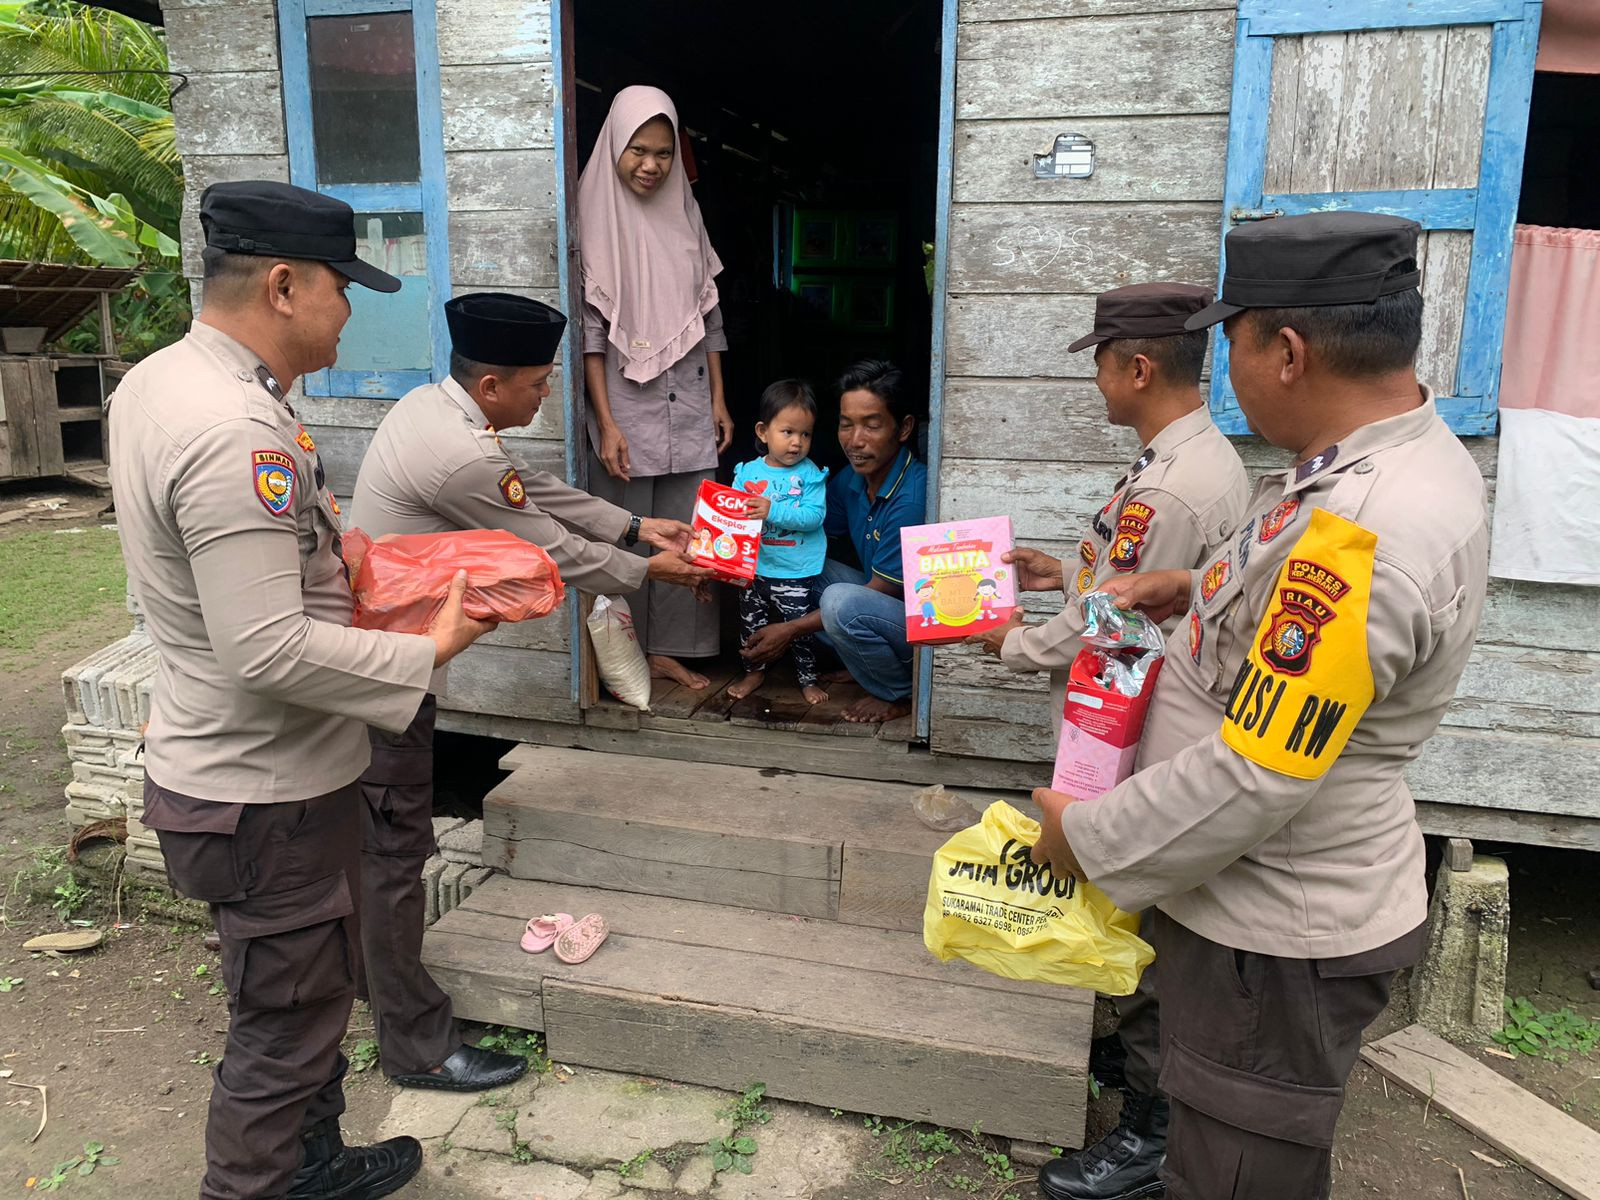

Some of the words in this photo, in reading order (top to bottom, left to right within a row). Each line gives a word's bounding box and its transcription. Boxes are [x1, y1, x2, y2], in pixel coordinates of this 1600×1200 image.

[716, 495, 748, 511] SGM
[711, 514, 748, 531] Eksplor
[920, 550, 990, 573] BALITA
[1294, 562, 1343, 591] POLRES
[1286, 592, 1327, 616] RIAU
[1225, 658, 1287, 738] LISI
[1285, 694, 1347, 759] RW
[943, 896, 984, 914] SUKARAMAI
[985, 904, 1007, 919] TRADE
[1008, 911, 1035, 925] CENTER
